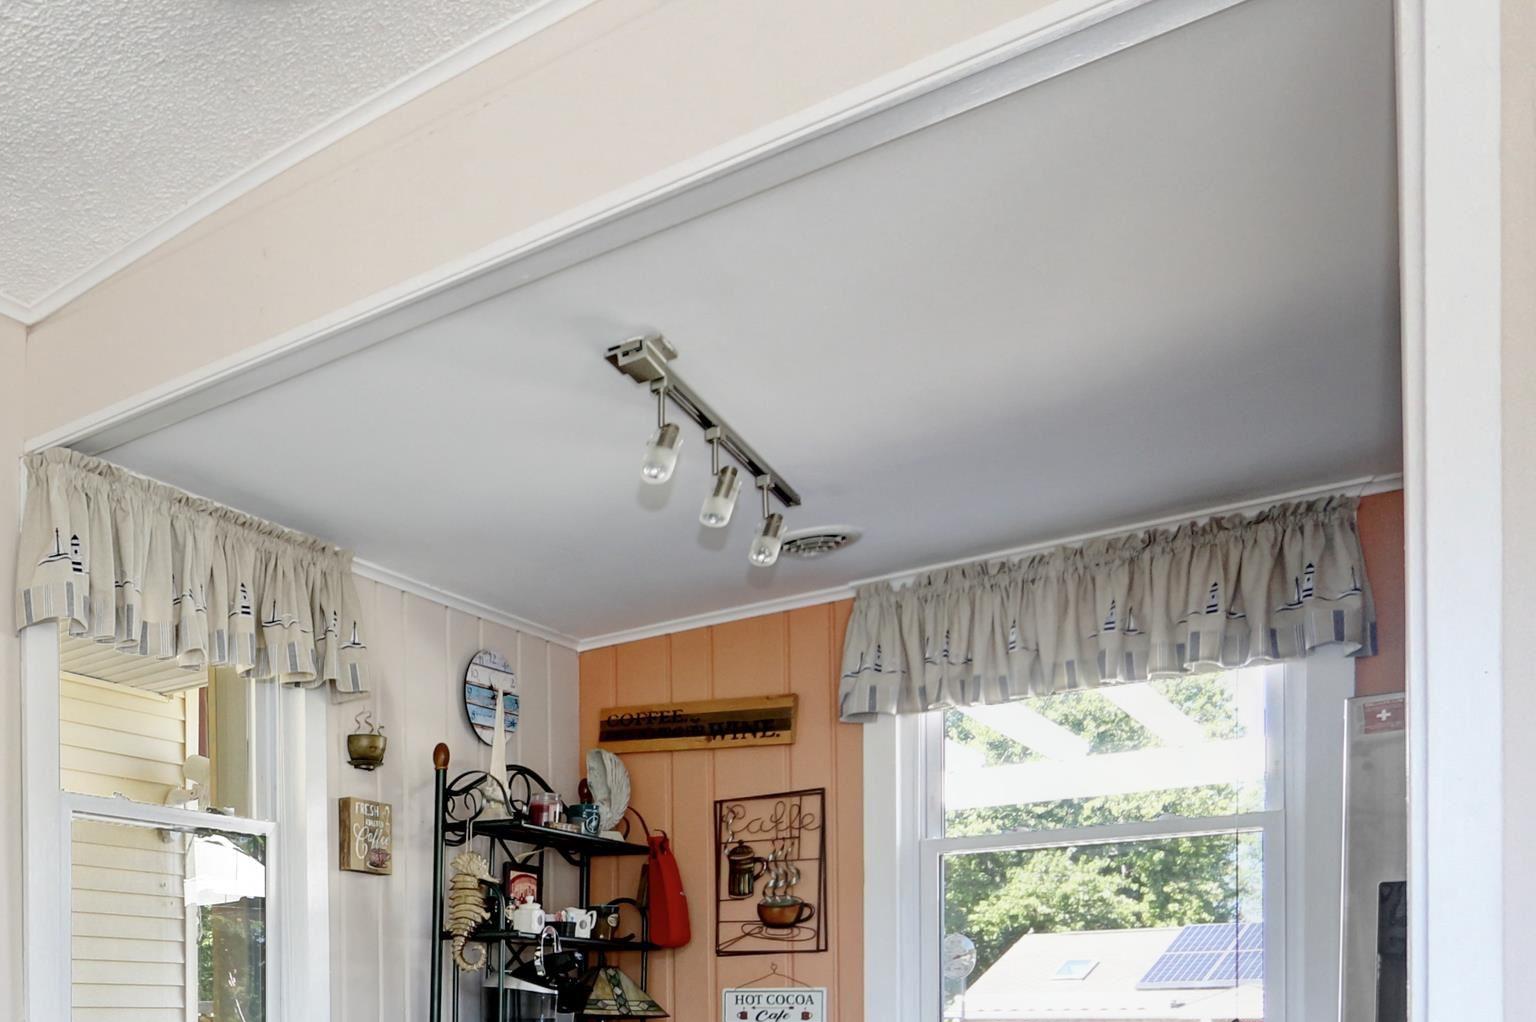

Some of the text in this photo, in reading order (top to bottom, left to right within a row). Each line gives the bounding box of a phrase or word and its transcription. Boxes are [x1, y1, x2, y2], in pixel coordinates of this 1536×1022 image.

[355, 801, 380, 817] FRESH
[734, 993, 815, 1006] HOT COCOA
